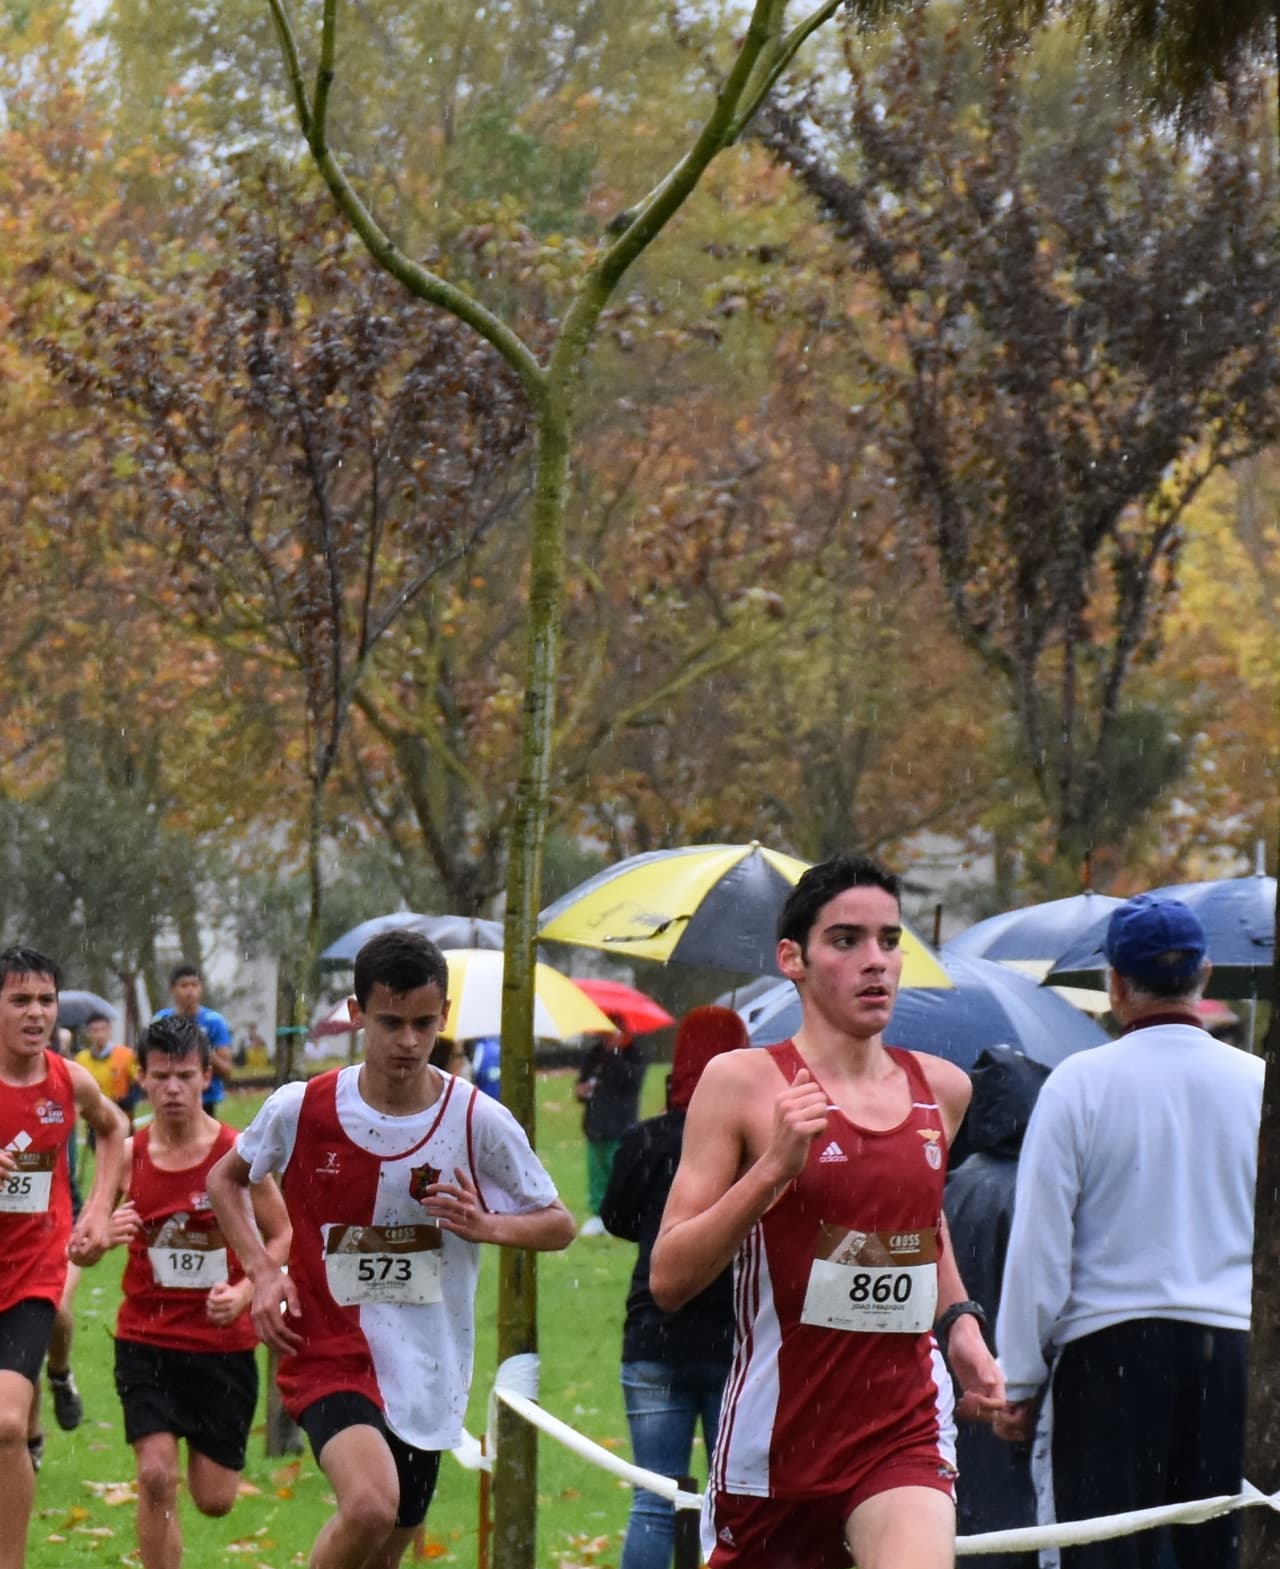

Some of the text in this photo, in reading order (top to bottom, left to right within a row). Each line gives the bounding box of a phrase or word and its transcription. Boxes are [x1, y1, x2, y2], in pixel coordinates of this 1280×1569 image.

[889, 1233, 920, 1247] CROSS
[168, 1252, 205, 1271] 187
[358, 1256, 412, 1281] 573
[849, 1273, 912, 1303] 860
